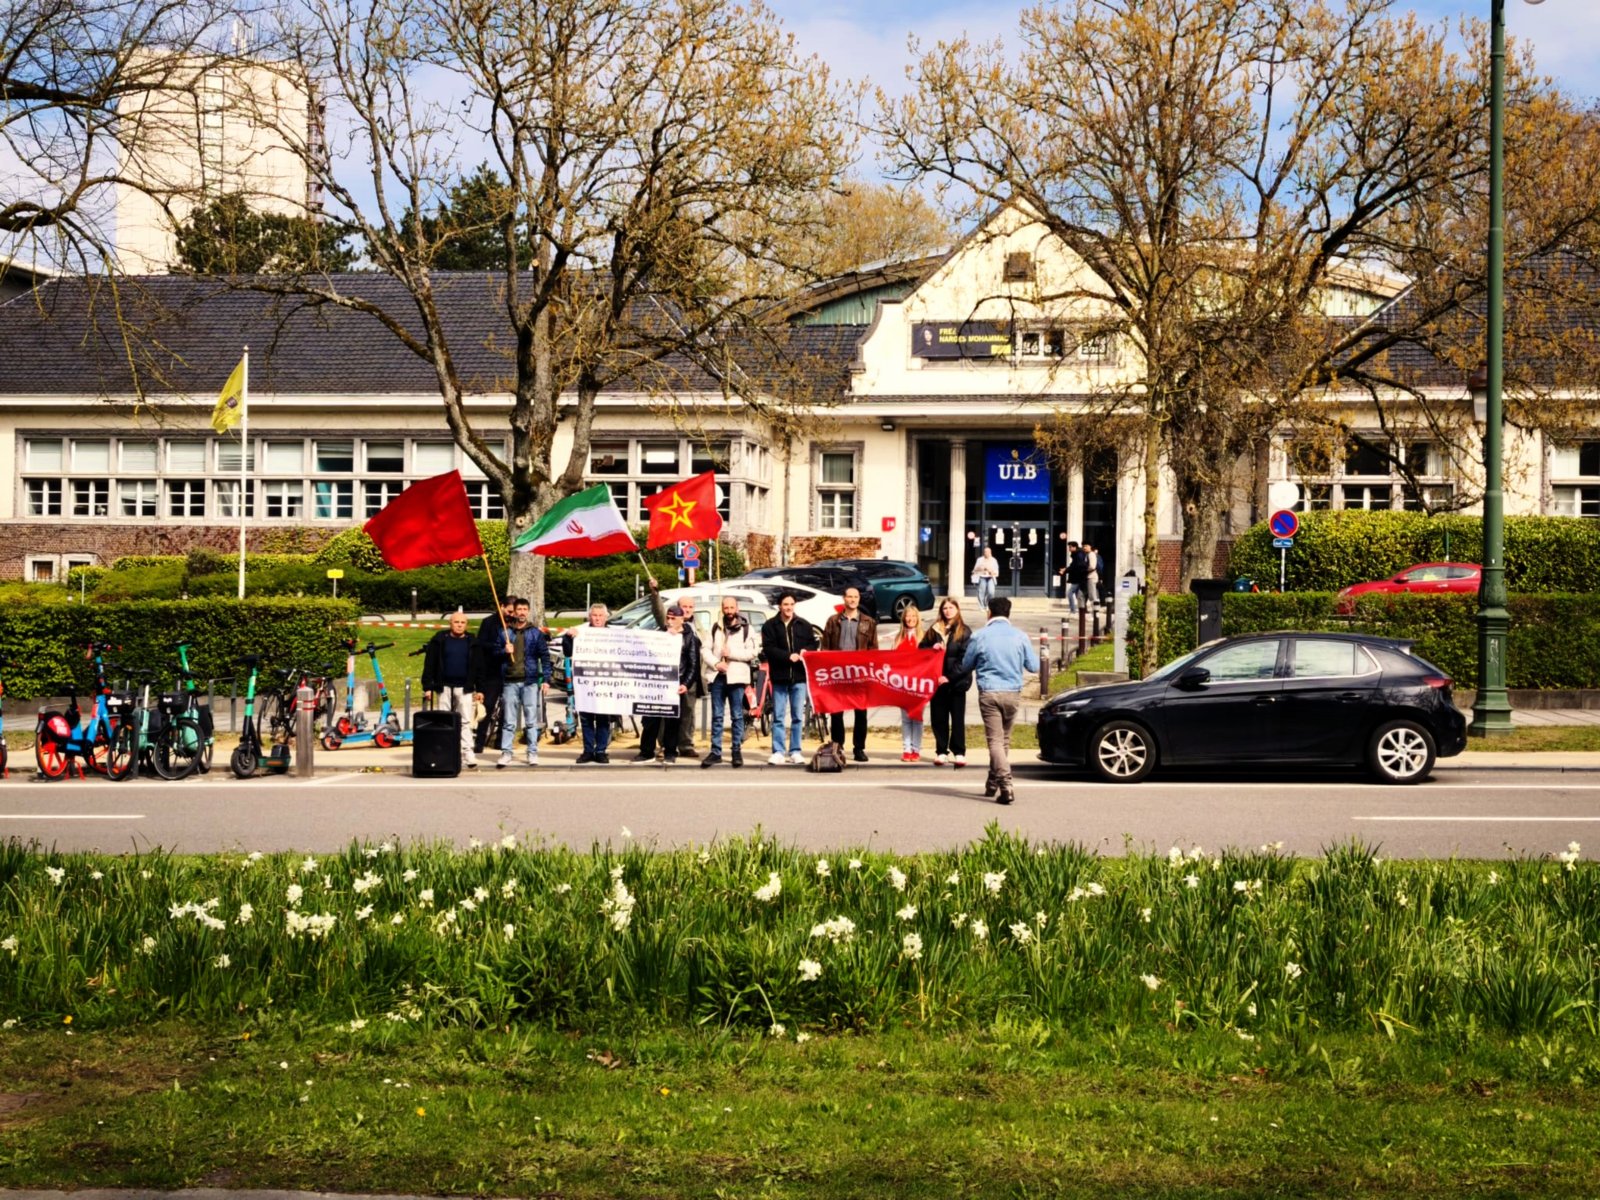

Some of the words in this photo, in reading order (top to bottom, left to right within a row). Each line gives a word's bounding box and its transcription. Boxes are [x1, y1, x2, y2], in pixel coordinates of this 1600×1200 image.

[998, 464, 1037, 480] ULB
[617, 648, 648, 658] Occupants
[623, 663, 656, 671] volonté
[815, 662, 935, 693] samidoun
[593, 679, 630, 688] peuple
[634, 681, 669, 689] Iranien
[587, 690, 613, 698] n'est
